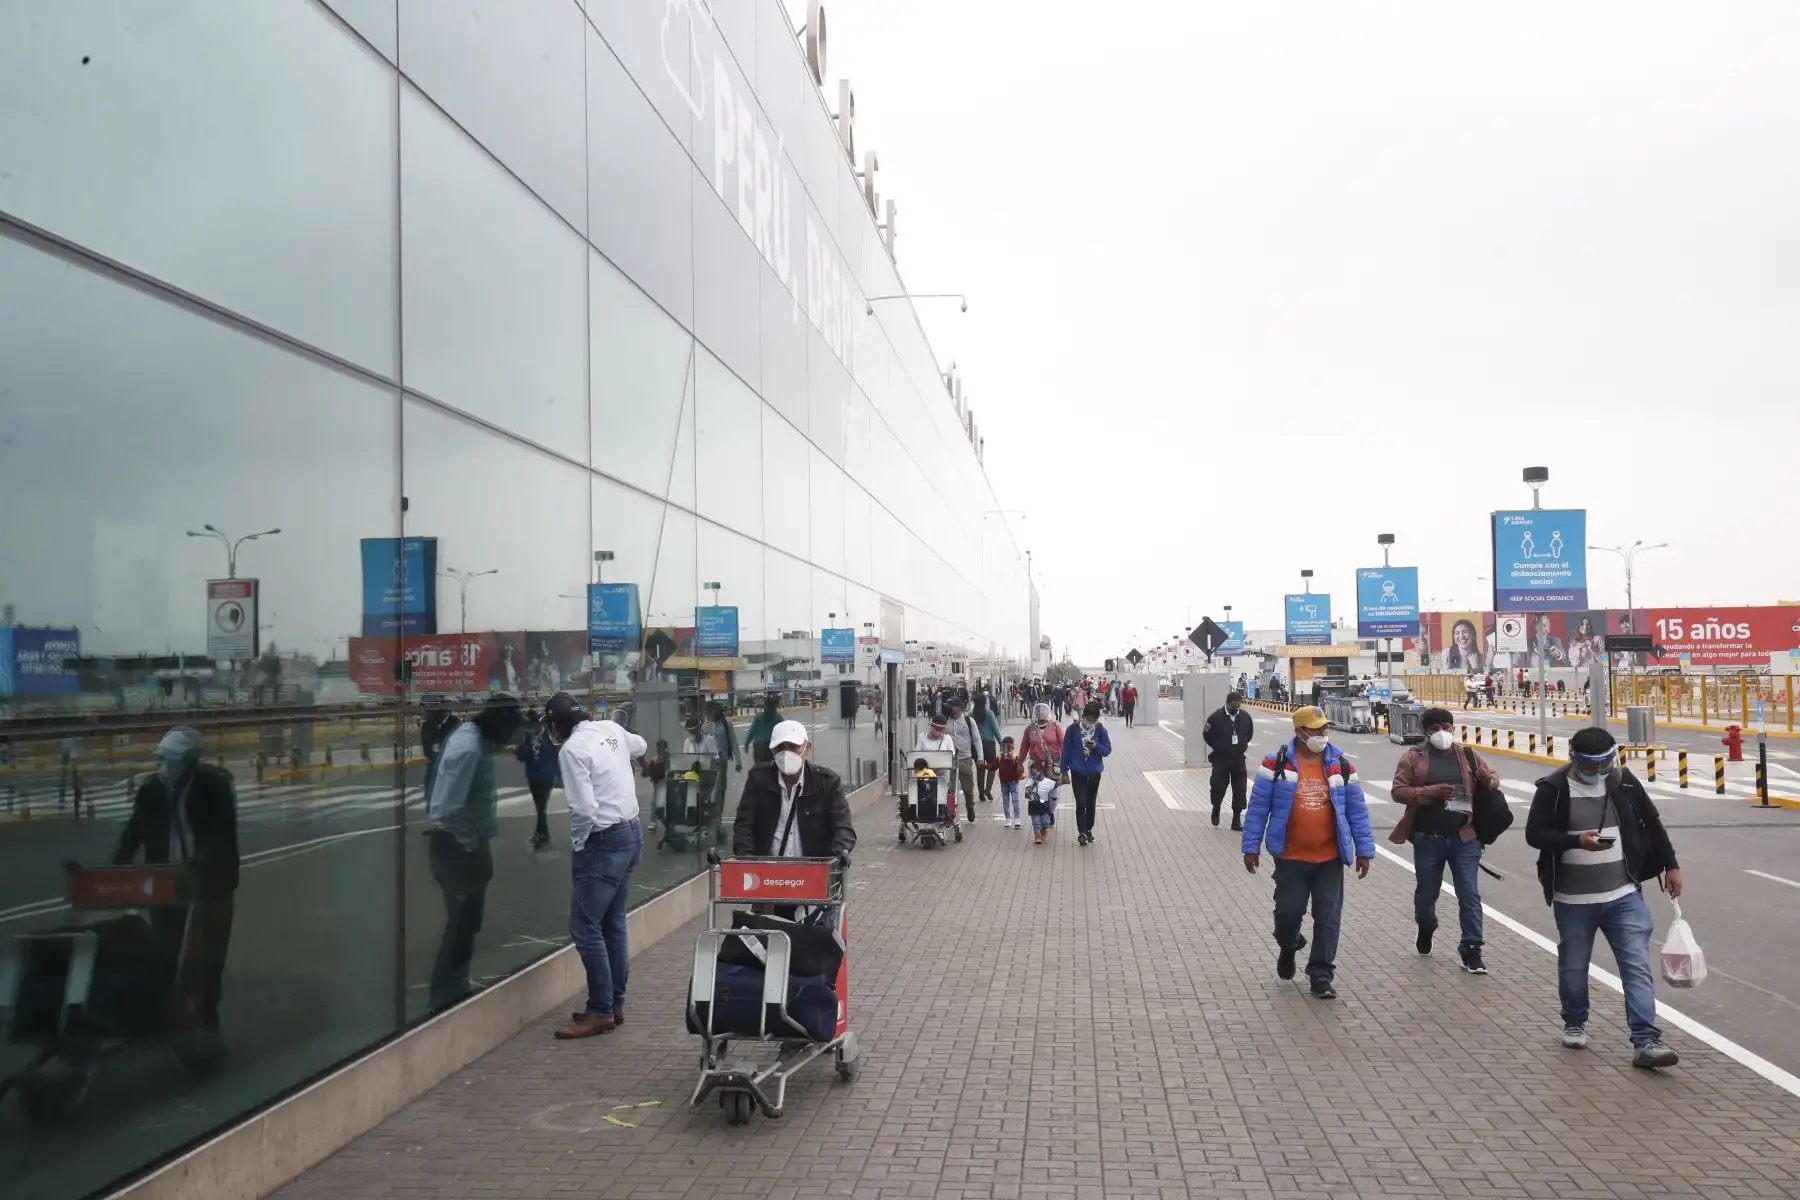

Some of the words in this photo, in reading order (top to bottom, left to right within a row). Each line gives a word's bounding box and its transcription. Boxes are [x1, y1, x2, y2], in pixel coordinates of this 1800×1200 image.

[1513, 562, 1543, 571] Cumple
[1656, 618, 1684, 640] 15
[1690, 617, 1751, 640] años
[1702, 642, 1744, 650] transformar
[1703, 651, 1718, 659] algo
[1718, 650, 1740, 659] mejor
[763, 878, 805, 887] despegar
